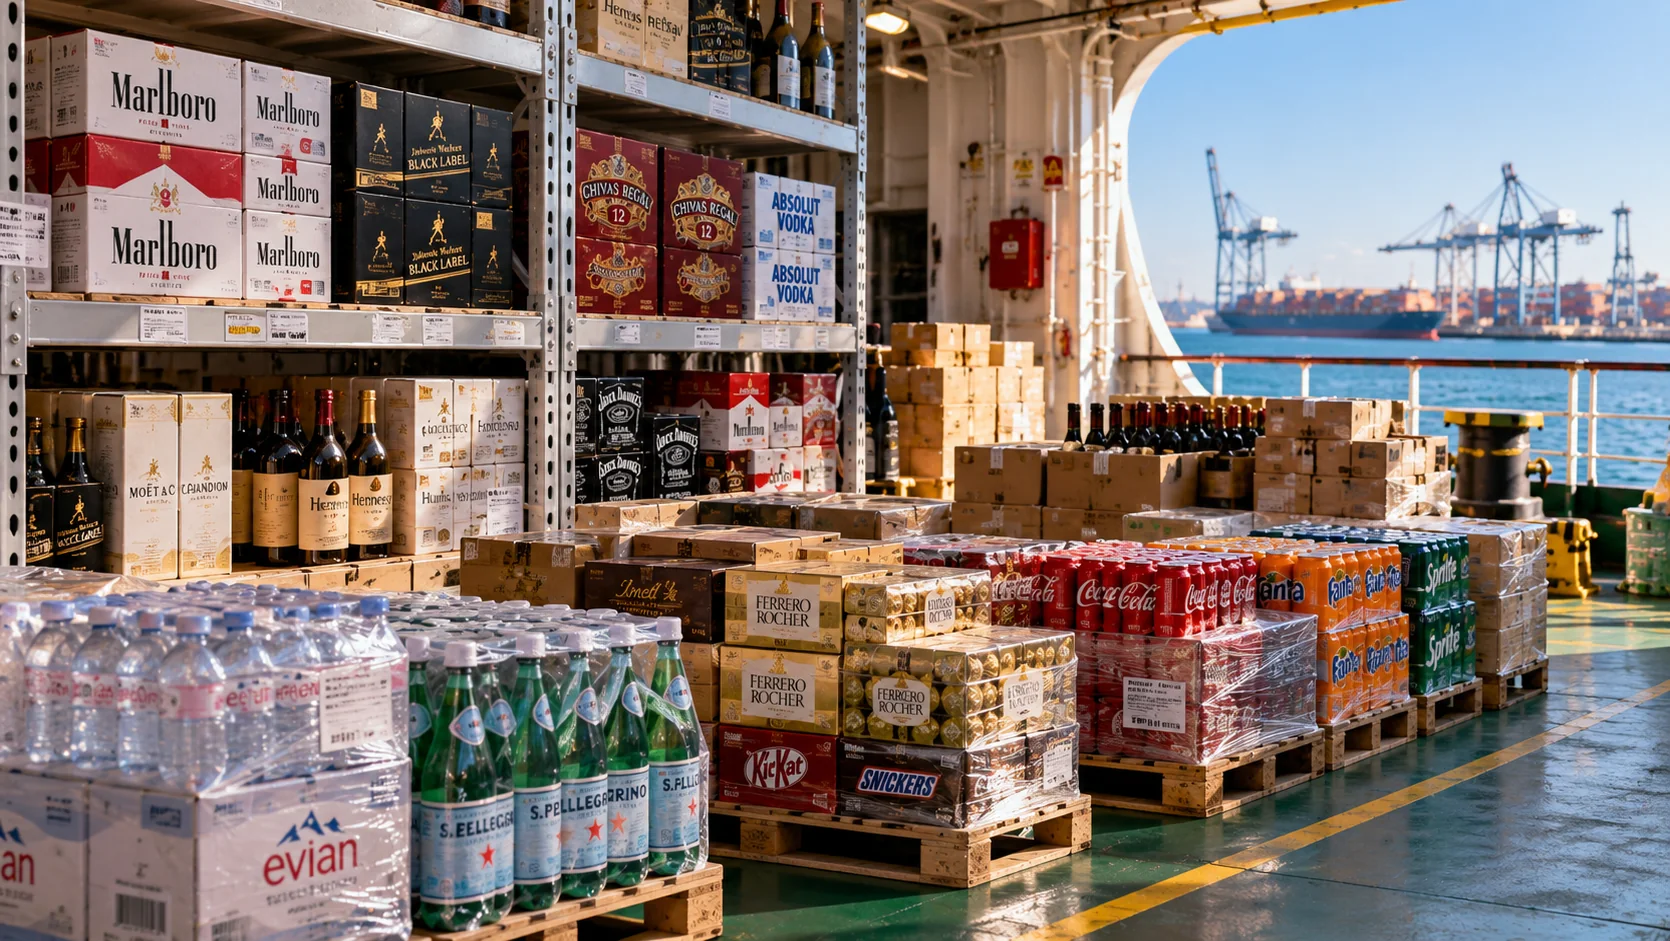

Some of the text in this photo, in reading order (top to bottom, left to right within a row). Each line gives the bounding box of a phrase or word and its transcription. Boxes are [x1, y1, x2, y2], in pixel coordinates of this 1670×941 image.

[110, 68, 217, 123] Marlboro
[256, 91, 320, 128] Marlboro
[408, 154, 469, 171] BLACK LABEL
[257, 175, 320, 205] Marlboro
[582, 181, 619, 200] CHIVAS
[673, 201, 737, 225] CHIVAS REGAL
[771, 191, 821, 216] ABSOLUT
[612, 208, 625, 223] 12
[777, 211, 815, 235] VODKA
[701, 224, 713, 239] 12
[111, 219, 217, 271] Marlboro
[256, 235, 320, 269] Marlboro
[408, 260, 439, 276] BLACK
[771, 263, 821, 286] ABSOLUT
[776, 283, 814, 305] VODKA
[756, 594, 811, 613] FERRERO
[756, 609, 810, 628] ROCHER
[750, 673, 807, 693] FERRERO
[750, 688, 805, 708] ROCHER
[879, 700, 923, 716] ROCHER
[859, 768, 939, 797] SNICKERS
[263, 837, 359, 887] evian
